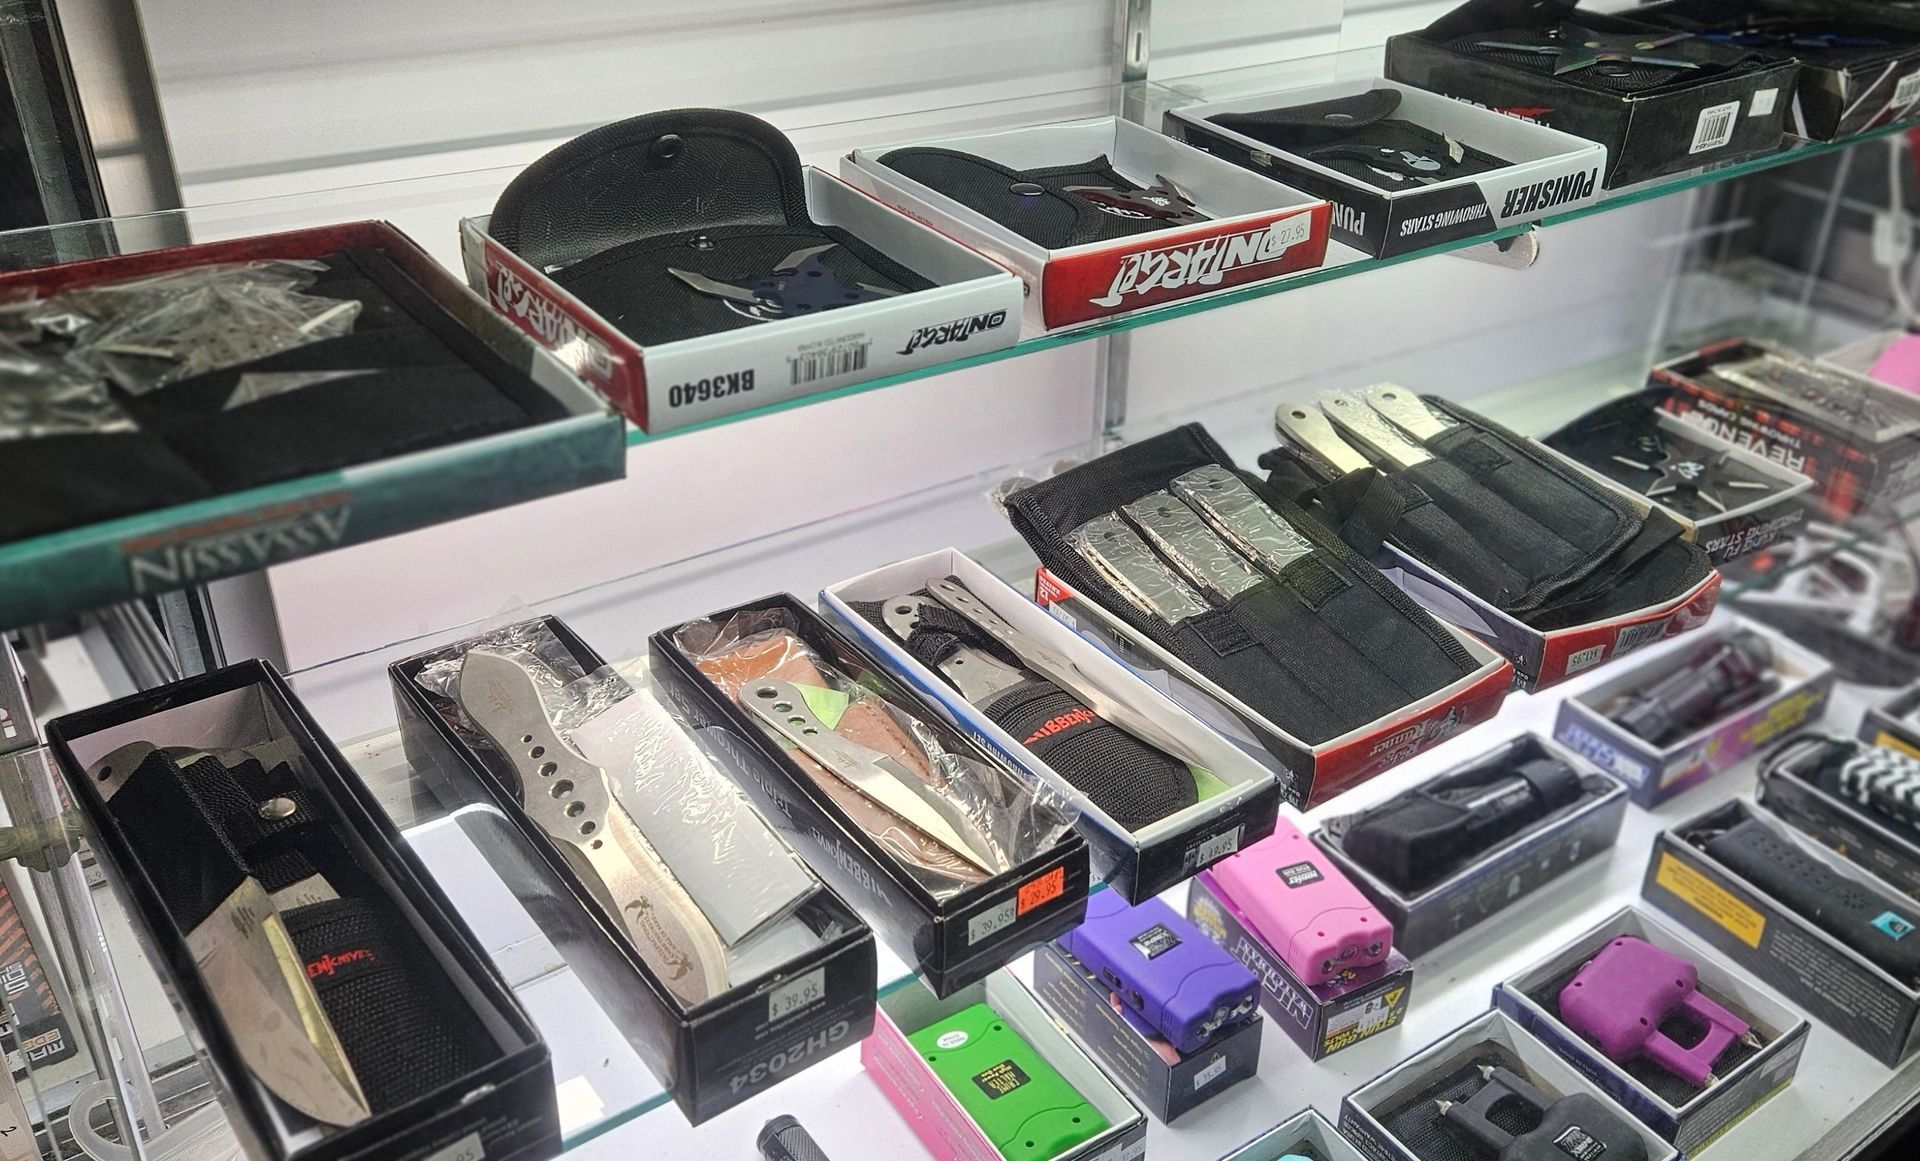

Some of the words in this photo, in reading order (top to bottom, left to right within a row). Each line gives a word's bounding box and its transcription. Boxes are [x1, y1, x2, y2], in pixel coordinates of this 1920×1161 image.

[1501, 168, 1598, 219] PUNISHER
[1400, 217, 1431, 237] STARS
[1433, 203, 1488, 230] THROWING
[1281, 222, 1305, 245] 27.95
[668, 368, 755, 408] BK3640
[1740, 415, 1800, 448] THROWING
[128, 505, 352, 591] ASSASSIN
[1705, 531, 1744, 553] STARS
[1723, 542, 1743, 559] FU
[670, 686, 691, 713] Set
[694, 712, 749, 776] Thrower
[1368, 718, 1430, 758] Runner
[752, 769, 792, 819] Triple
[1209, 839, 1233, 858] 49.95
[1030, 882, 1057, 905] 29.95
[784, 983, 819, 1011] 39.95
[1326, 1033, 1358, 1054] GUN
[730, 1020, 850, 1095] GH2034
